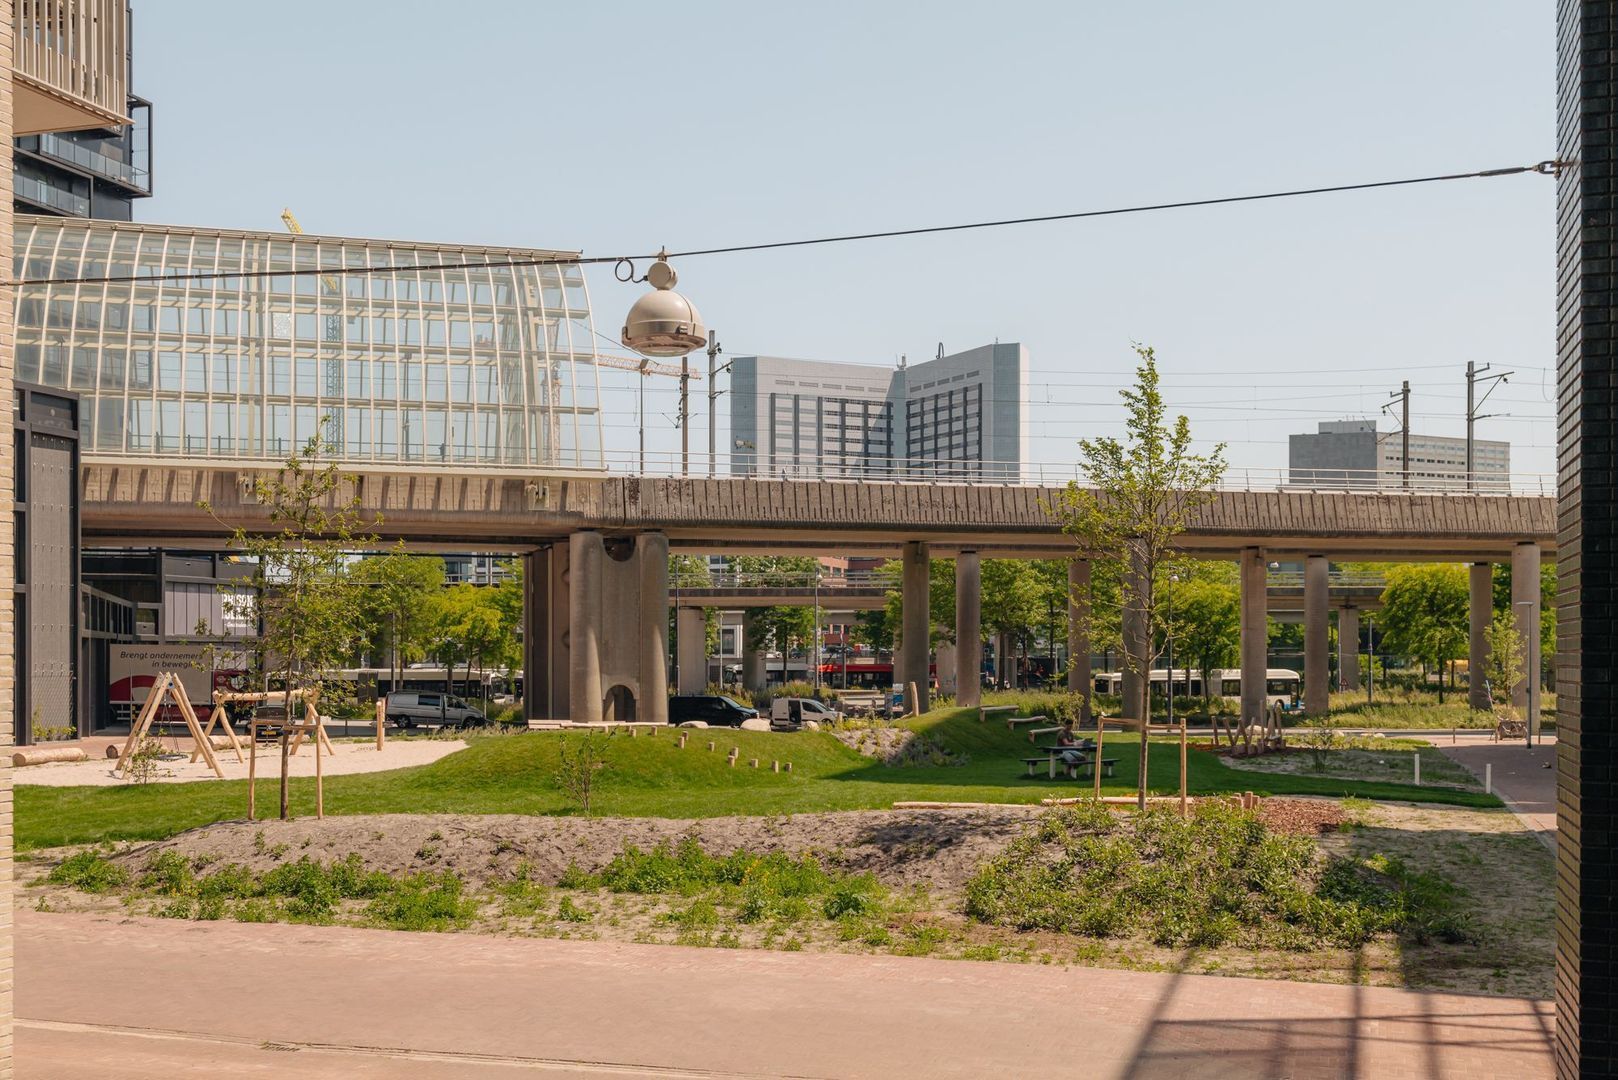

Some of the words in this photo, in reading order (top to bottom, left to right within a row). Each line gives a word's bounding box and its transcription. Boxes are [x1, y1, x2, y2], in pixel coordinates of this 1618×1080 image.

[221, 594, 253, 606] PRISON
[120, 651, 148, 660] Brengt
[150, 652, 203, 660] ondernemers
